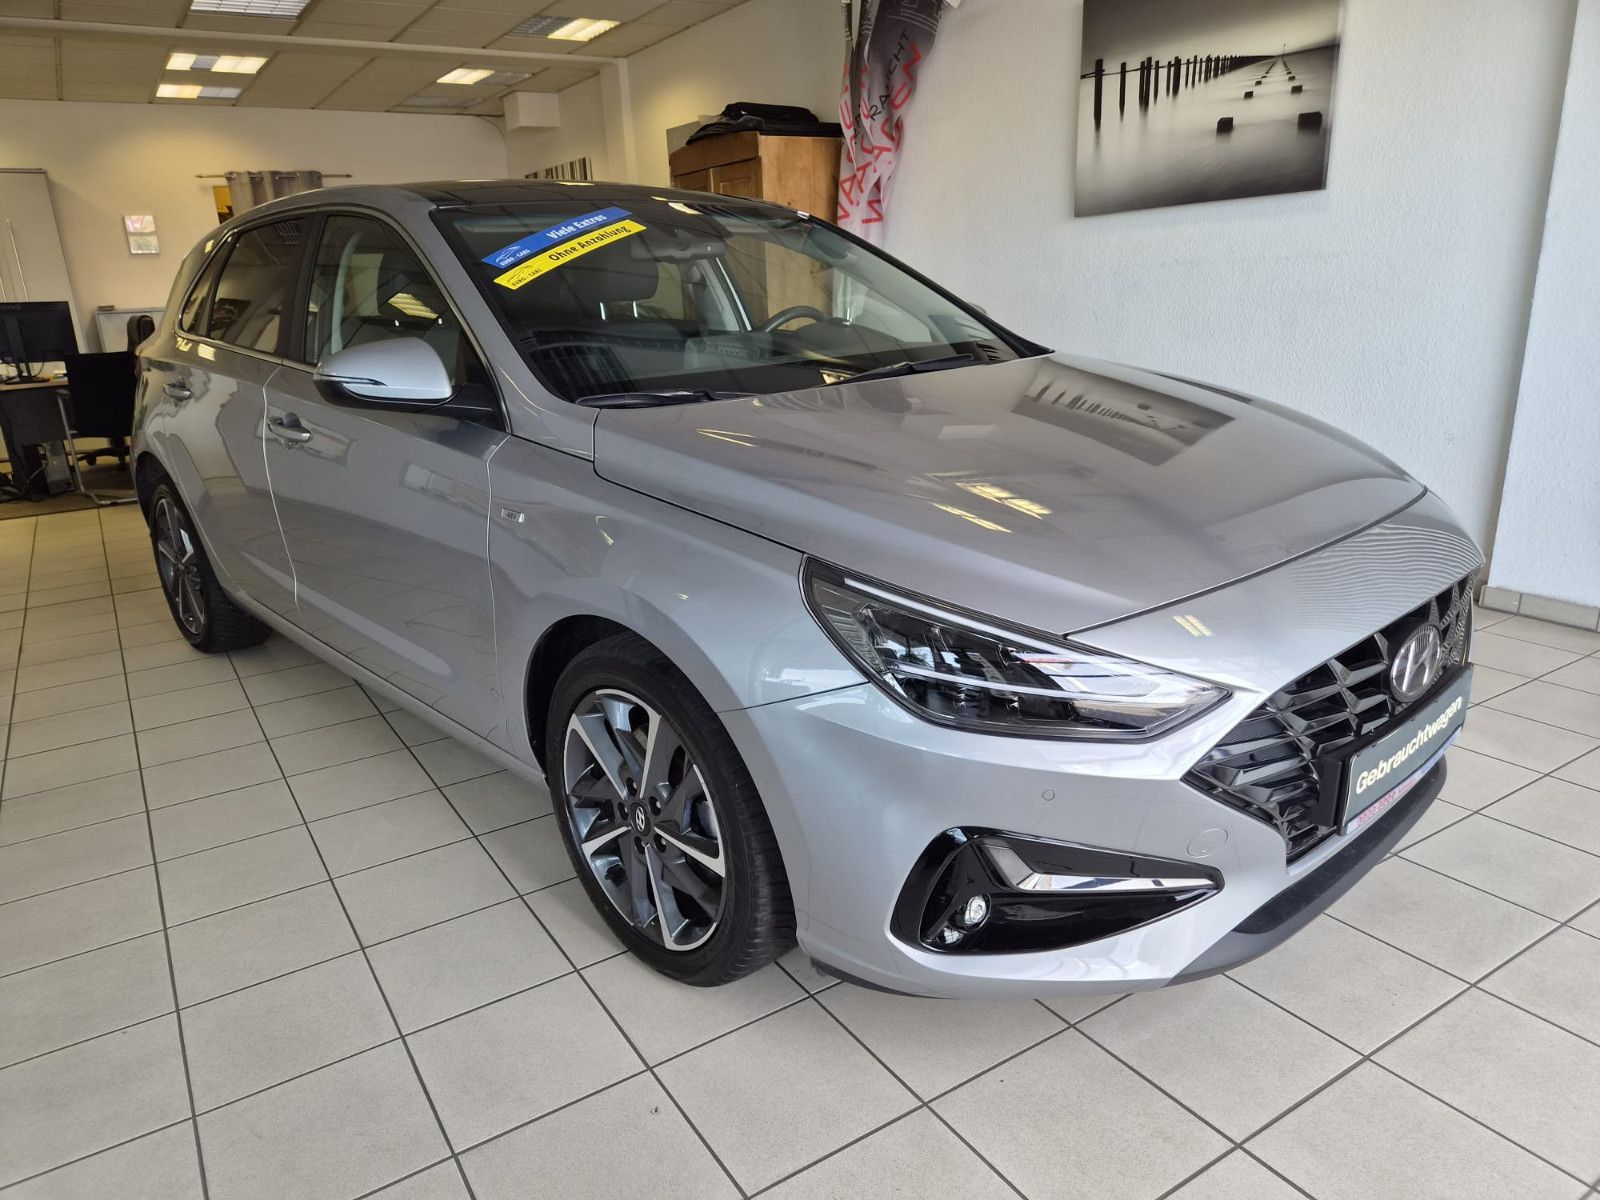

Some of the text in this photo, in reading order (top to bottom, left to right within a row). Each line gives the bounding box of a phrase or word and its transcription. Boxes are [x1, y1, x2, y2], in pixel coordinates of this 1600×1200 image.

[546, 214, 607, 240] Viele Extras
[548, 225, 631, 262] Ohne Anzahlung
[1355, 696, 1463, 795] Gebrauchtwagen
